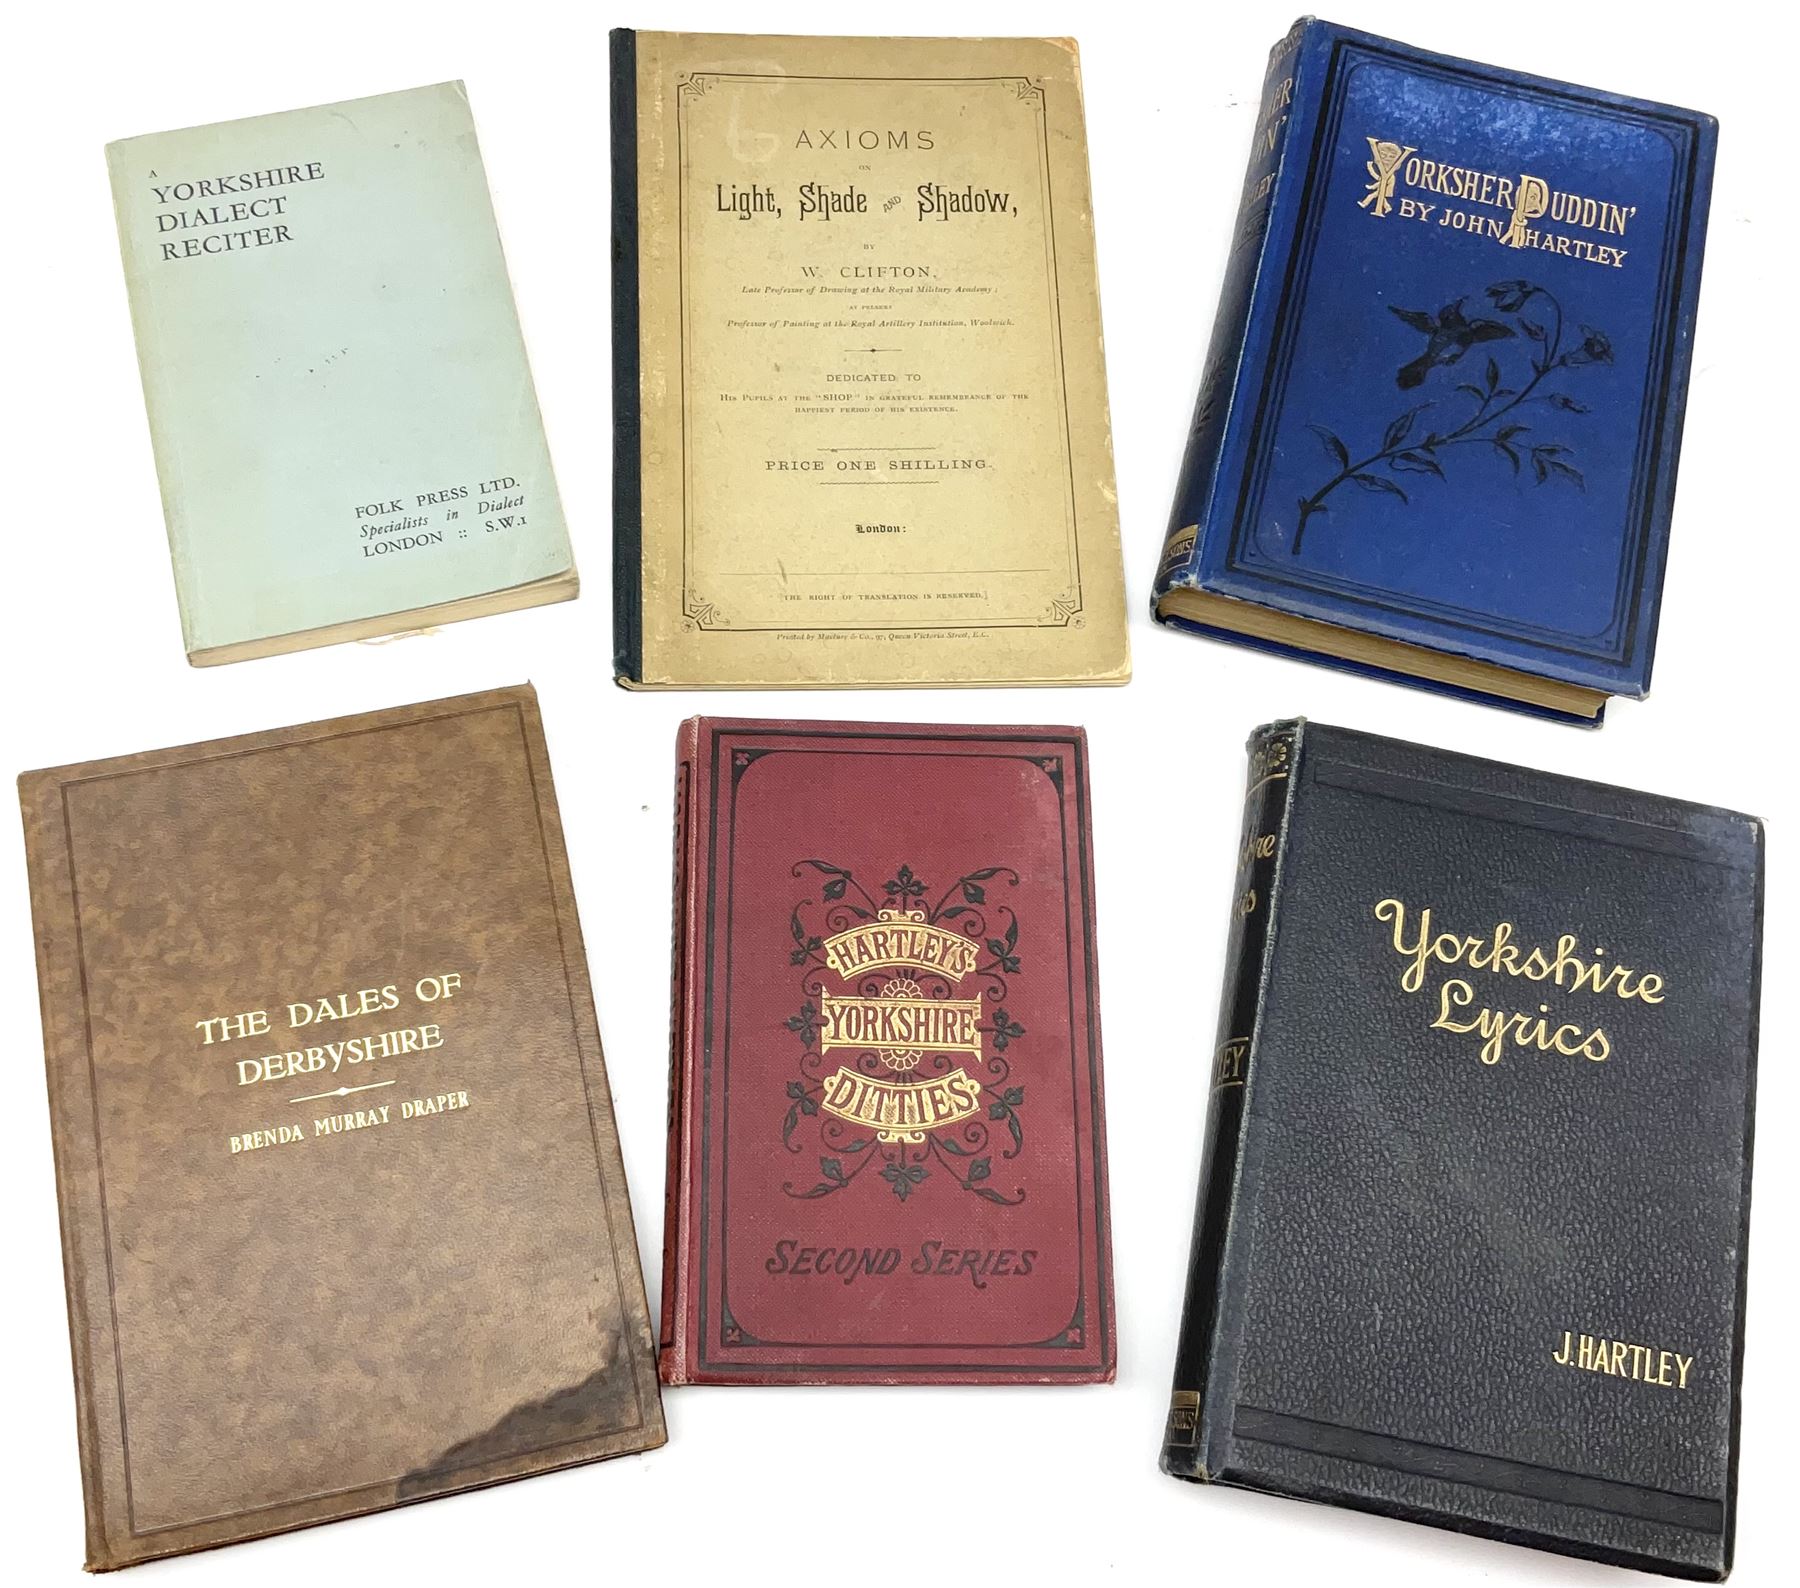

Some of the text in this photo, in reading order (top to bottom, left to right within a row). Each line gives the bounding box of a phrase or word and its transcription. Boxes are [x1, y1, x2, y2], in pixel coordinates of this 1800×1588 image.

[795, 129, 935, 150] AXIOMS
[149, 169, 158, 179] A
[151, 162, 325, 204] YORKSHIRE
[1364, 137, 1514, 218] YORKSHER
[1519, 174, 1637, 249] PUDDIN'
[156, 195, 287, 232] DIALECT
[716, 181, 1018, 221] Light, Shade AND Shadow,
[160, 225, 294, 261] RECITER
[1398, 198, 1628, 268] BY JOHN HARTLEY
[741, 286, 761, 294] Late
[764, 286, 804, 295] Professor
[806, 286, 816, 295] of
[819, 286, 857, 295] Drawing
[860, 286, 870, 294] at
[888, 286, 913, 295] Royal
[916, 286, 952, 294] Military
[800, 265, 823, 278] W.
[727, 319, 767, 328] Professor
[769, 319, 779, 328] of
[783, 320, 820, 328] Painting
[834, 319, 848, 327] the
[850, 319, 876, 328] Royal
[879, 319, 915, 328] Artillery
[919, 319, 967, 328] Institution,
[970, 318, 1015, 327] Woolwich.
[826, 373, 921, 382] DEDICATED TO
[765, 461, 825, 471] PRICE
[836, 461, 877, 471] ONE
[354, 476, 520, 518] FOLK PRESS LTD.
[360, 495, 524, 540] Specialists in Dialect
[362, 531, 444, 557] LONDON
[806, 633, 815, 641] by
[888, 633, 911, 641] Queen
[830, 929, 973, 974] HARTLEY'S
[1374, 898, 1666, 1004] Yorkshire
[195, 973, 462, 1045] THE DALES OF
[827, 1003, 976, 1044] YORKSHIRE
[1430, 979, 1611, 1065] Lyrics
[236, 1024, 444, 1086] DERBYSHIRE
[827, 1071, 974, 1125] DITTIES
[230, 1090, 471, 1154] BRENDA MURRAY DRAPER
[764, 1239, 1038, 1290] SECOND SERIES
